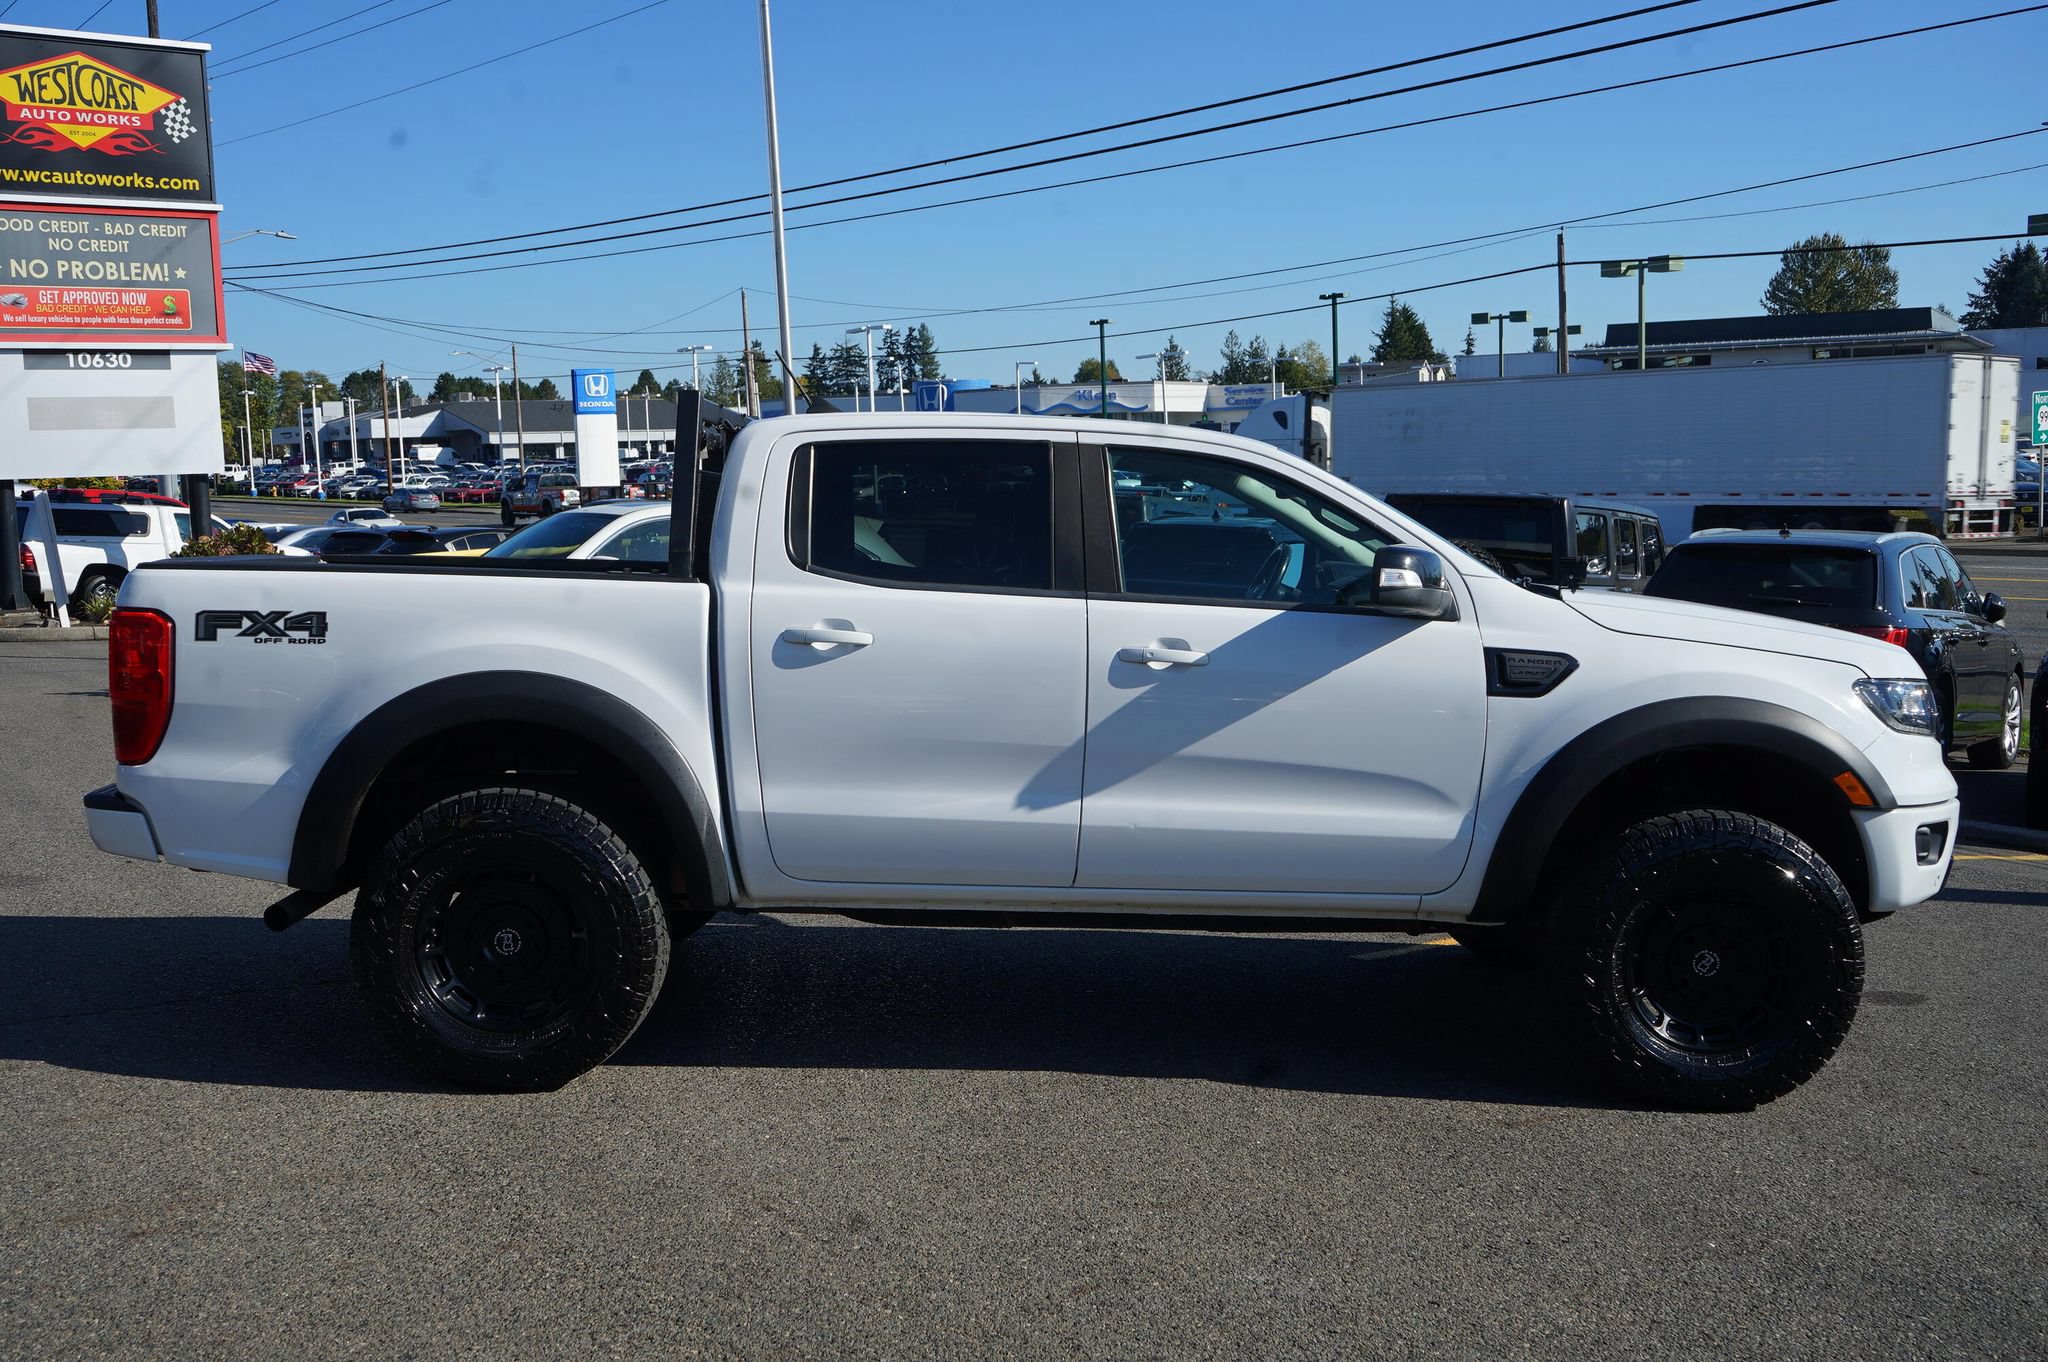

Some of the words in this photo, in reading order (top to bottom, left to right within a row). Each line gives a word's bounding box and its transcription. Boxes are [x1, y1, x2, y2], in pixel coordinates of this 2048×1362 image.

[20, 108, 71, 122] AUTO
[76, 112, 141, 126] WORKS
[0, 168, 200, 191] w.wcautoworks.com
[38, 219, 89, 234] CREDIT
[104, 222, 135, 236] BAD
[139, 223, 188, 238] CREDIT
[48, 238, 73, 251] NO
[78, 239, 129, 253] CREDIT
[10, 259, 49, 279] NO
[57, 260, 170, 282] PROBLEM!
[39, 290, 59, 304] GET
[63, 291, 118, 305] APPROVED
[122, 292, 147, 306] NOW
[36, 304, 54, 313] BAD
[56, 304, 87, 313] CREDIT
[94, 305, 108, 314] WE
[110, 305, 128, 314] CAN
[130, 306, 151, 314] HELP
[3, 314, 14, 322] We
[16, 314, 27, 323] sell
[28, 314, 47, 324] luxury
[48, 315, 73, 323] vehicles
[81, 316, 101, 324] people
[117, 316, 129, 324] less
[144, 317, 164, 325] perfect
[65, 352, 132, 368] 10630
[1077, 389, 1117, 401] Klen
[1224, 385, 1264, 394] Service
[1225, 396, 1264, 406] Center
[195, 610, 328, 641] FX4
[1508, 657, 1563, 666] RANGER
